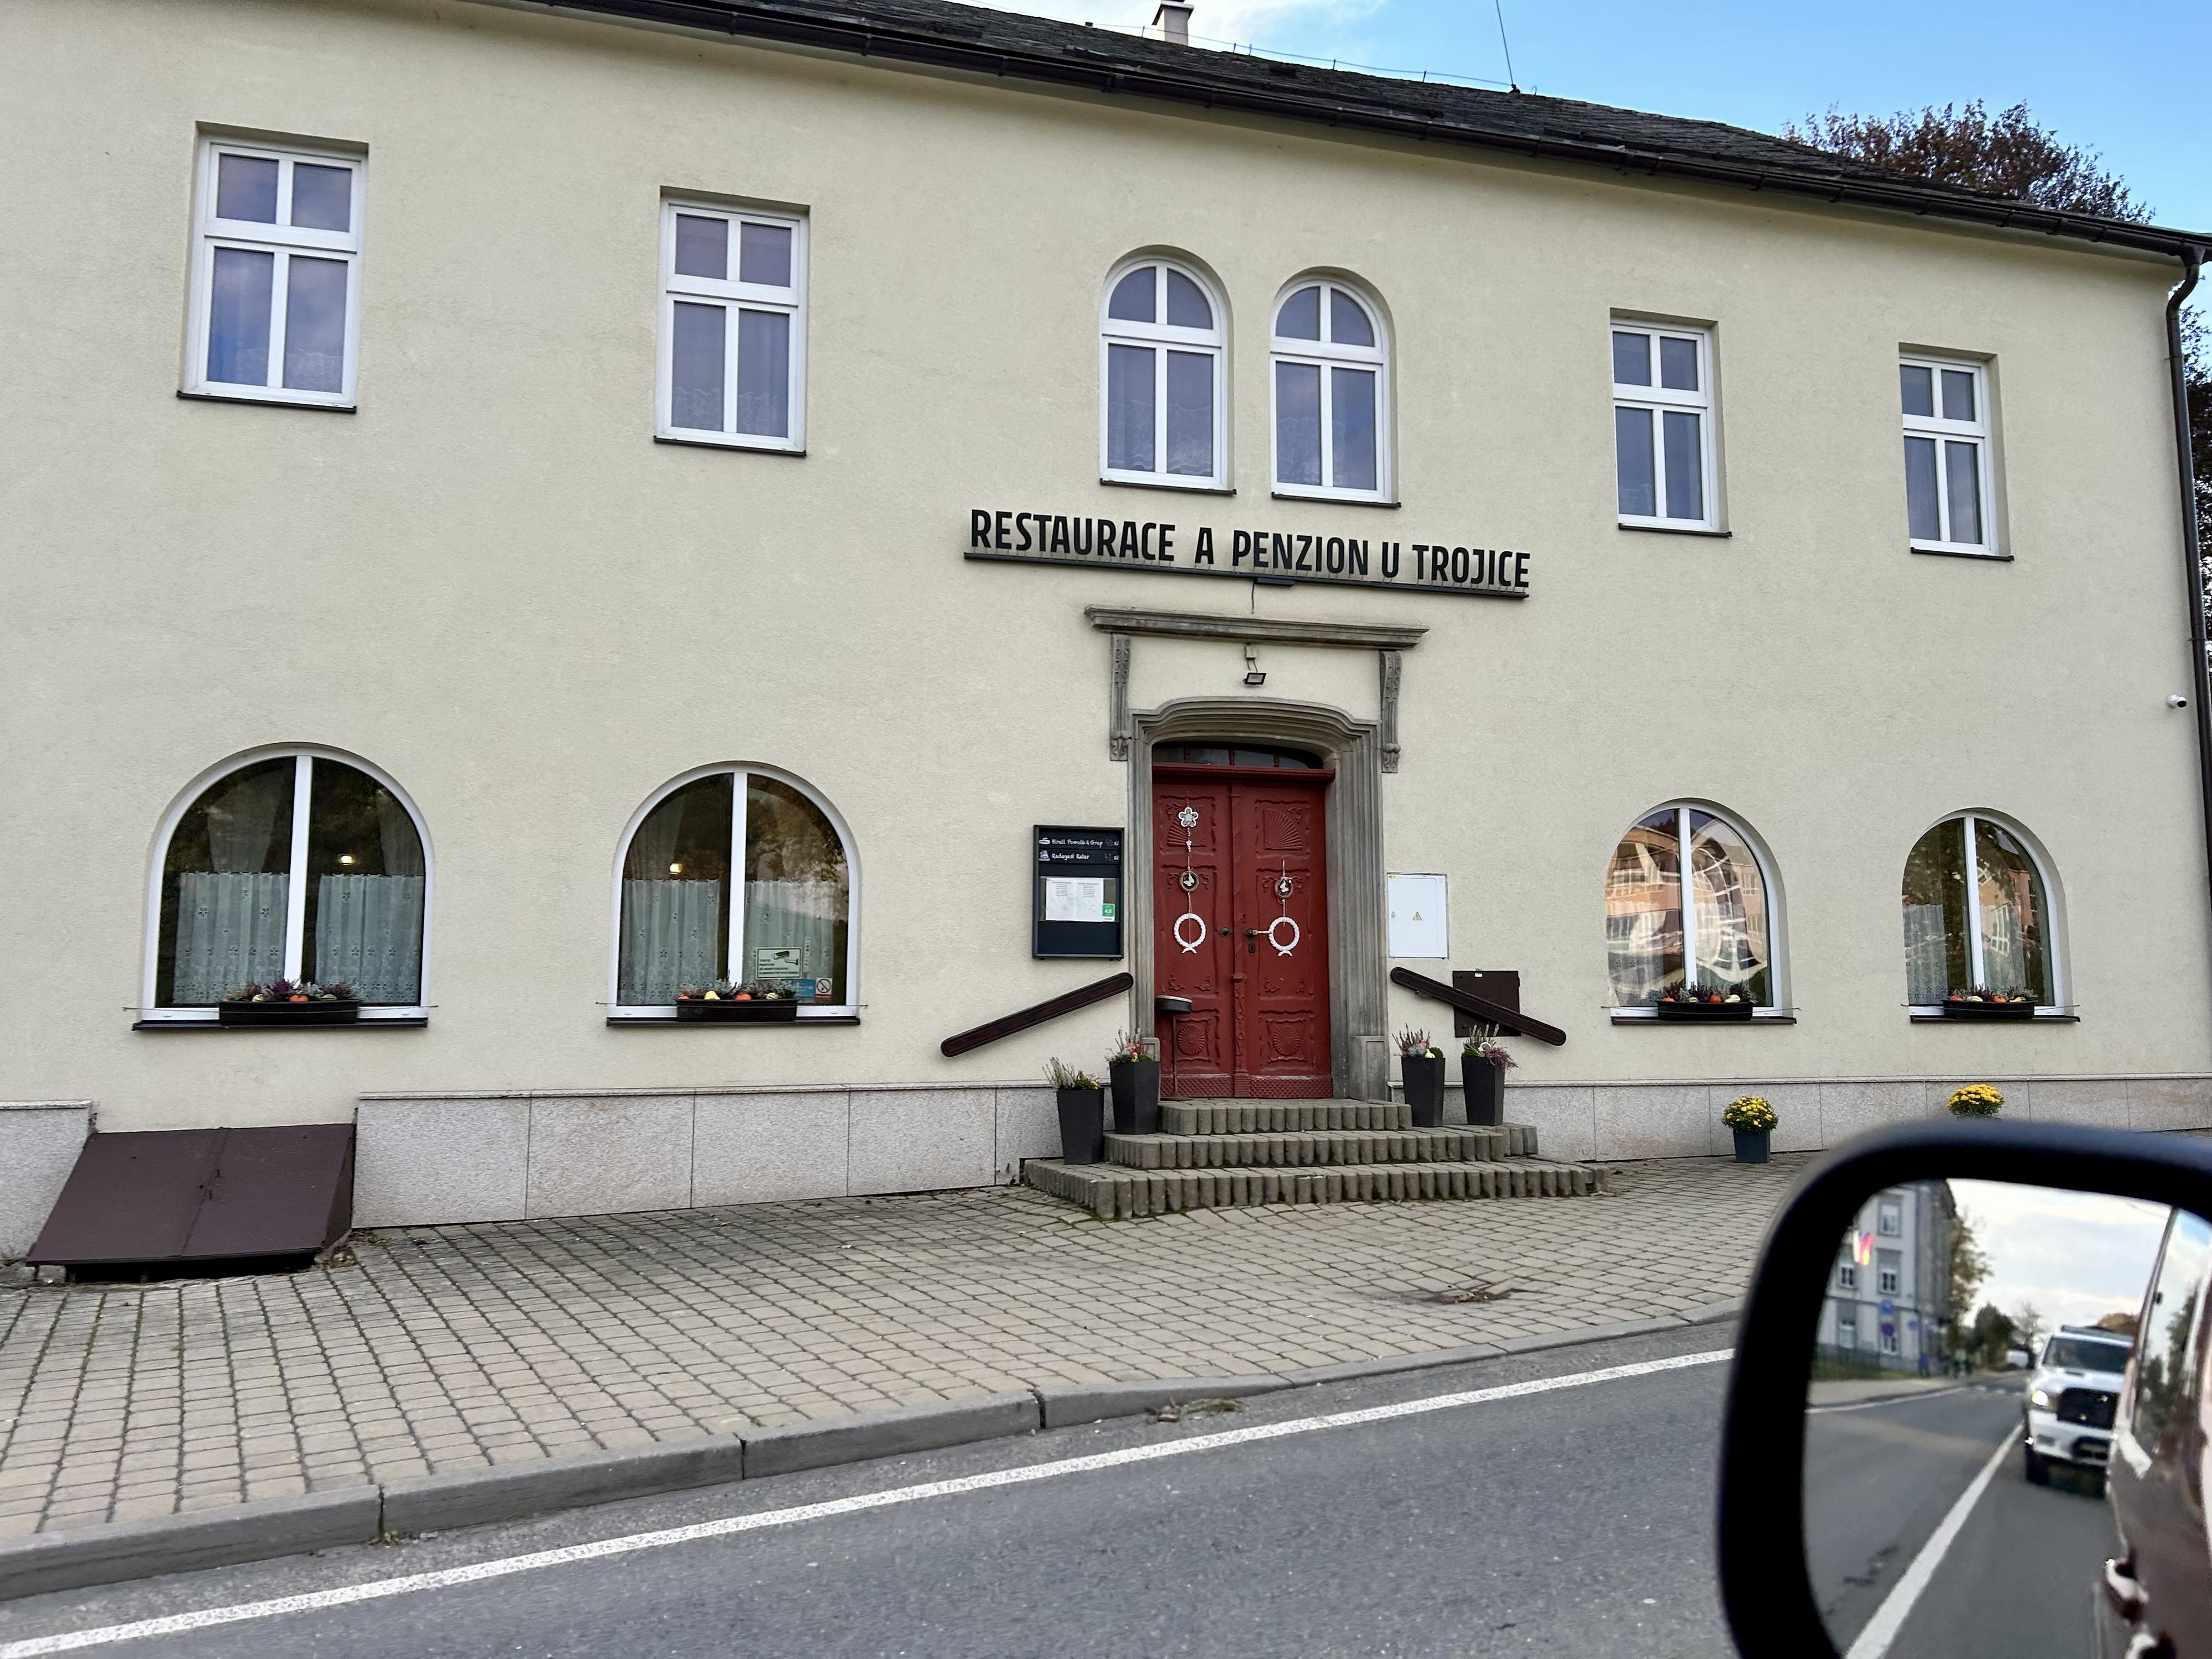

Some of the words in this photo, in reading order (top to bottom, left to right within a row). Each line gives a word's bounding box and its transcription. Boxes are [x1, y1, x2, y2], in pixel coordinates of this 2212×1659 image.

[971, 509, 1175, 562] RESTAURACE
[1194, 527, 1214, 565] A
[1232, 530, 1368, 576] PENZION
[1381, 541, 1400, 578] U
[1412, 544, 1531, 588] TROJICE
